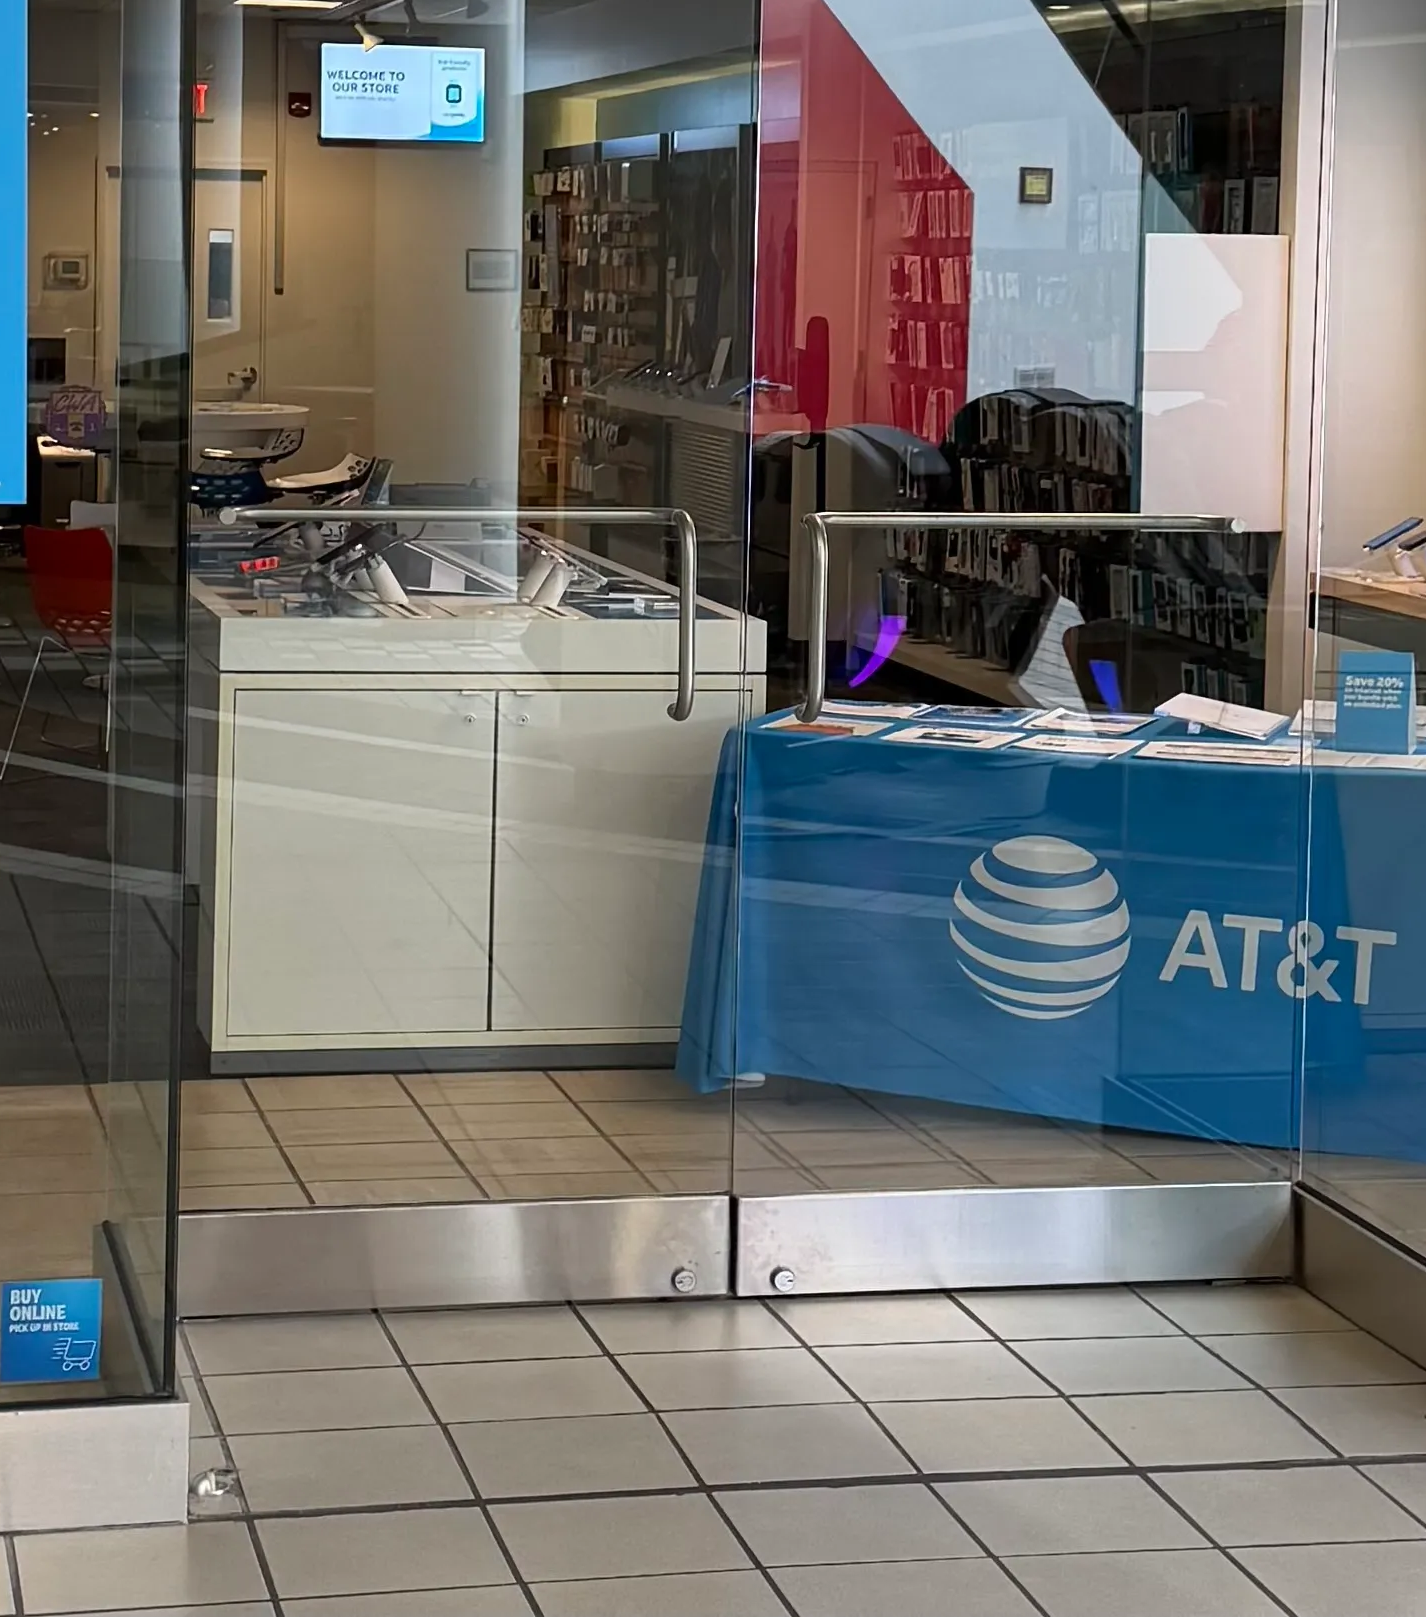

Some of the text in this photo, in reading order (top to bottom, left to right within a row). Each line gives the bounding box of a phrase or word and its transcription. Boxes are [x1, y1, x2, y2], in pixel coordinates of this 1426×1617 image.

[327, 69, 406, 82] WELCOME TO
[332, 81, 400, 94] OUR STORE
[1345, 675, 1405, 689] Save 20%
[1158, 908, 1398, 1006] AT&T
[10, 1288, 43, 1305] BUY
[9, 1304, 67, 1322] ONLINE
[9, 1323, 29, 1333] PICK
[29, 1323, 42, 1333] UP
